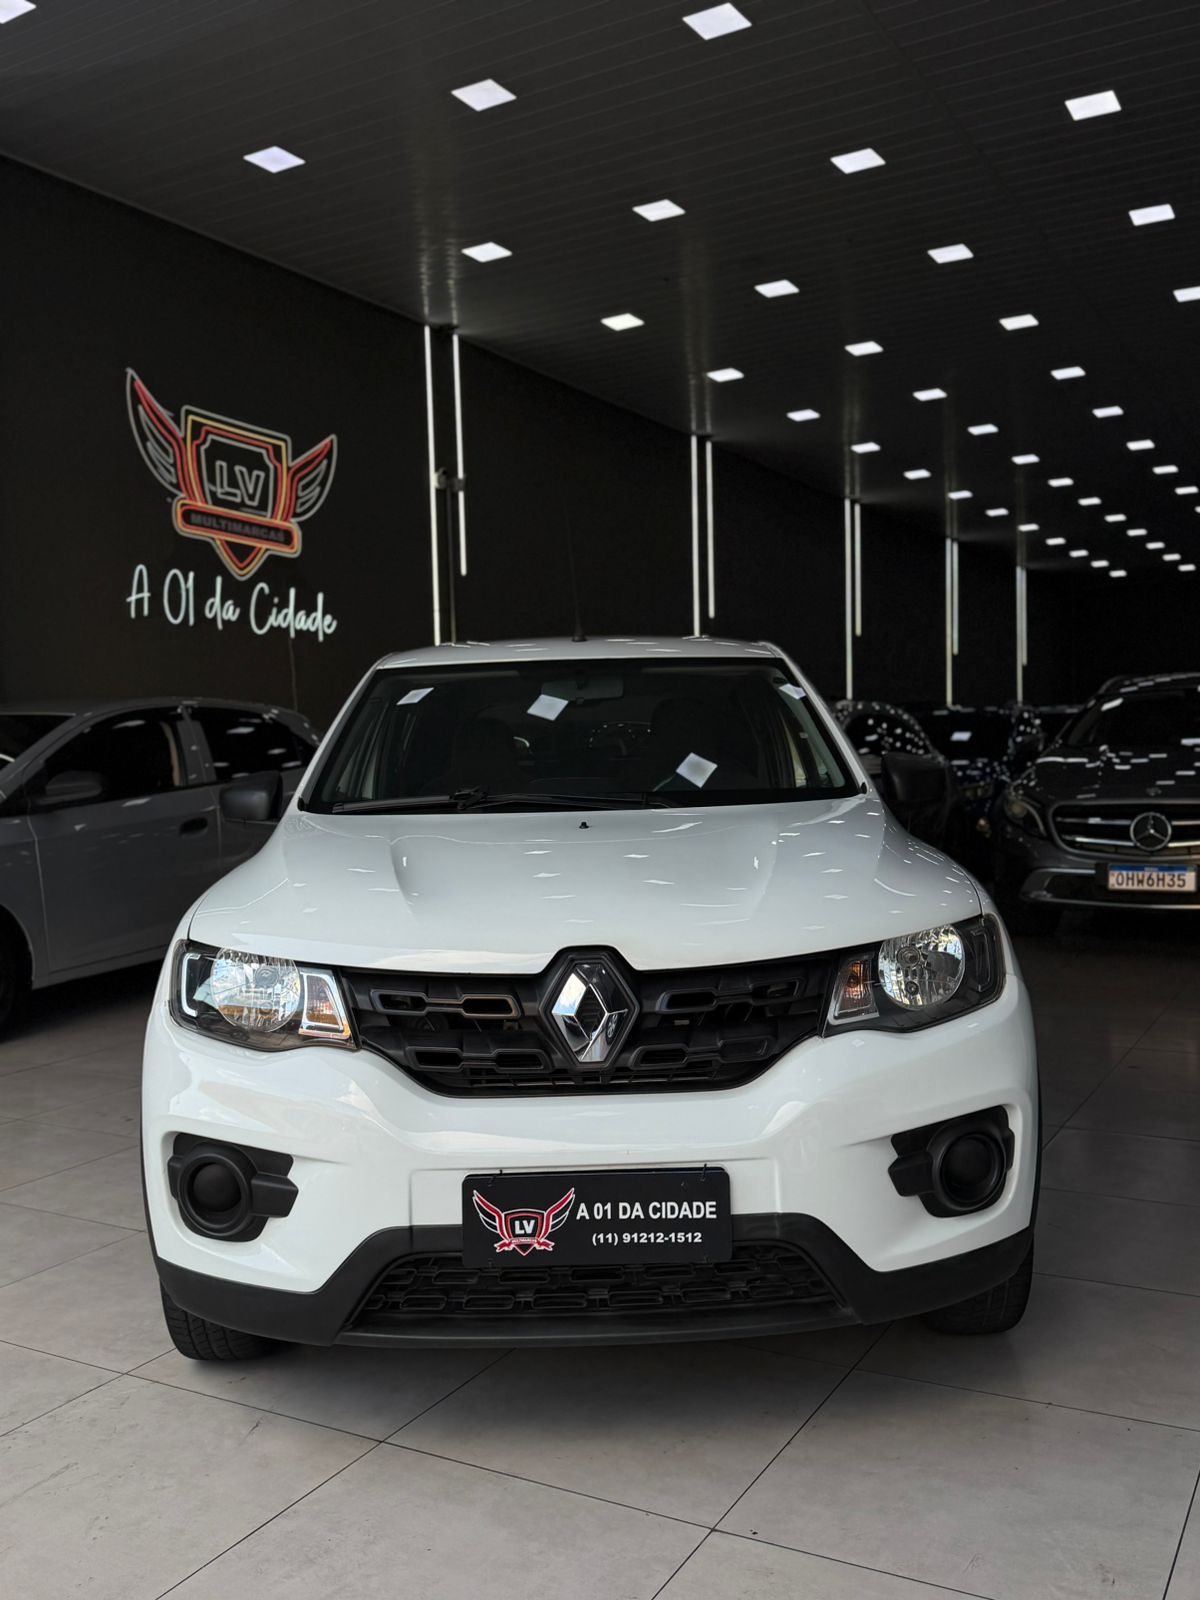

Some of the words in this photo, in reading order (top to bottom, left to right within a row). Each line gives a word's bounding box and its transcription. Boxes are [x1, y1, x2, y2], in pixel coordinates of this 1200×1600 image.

[215, 460, 265, 506] LV
[190, 512, 285, 542] MULTIMARCAS
[126, 564, 151, 618] A
[163, 568, 195, 626] 01
[204, 575, 240, 630] da
[250, 582, 337, 642] Cidade
[1115, 872, 1186, 888] OHW6H35
[576, 1203, 589, 1219] A
[593, 1203, 612, 1219] 01
[619, 1202, 644, 1219] DA
[648, 1201, 717, 1219] CIDADE
[514, 1220, 535, 1234] LV
[592, 1232, 619, 1245] (11)
[622, 1231, 702, 1244] 91212-1512
